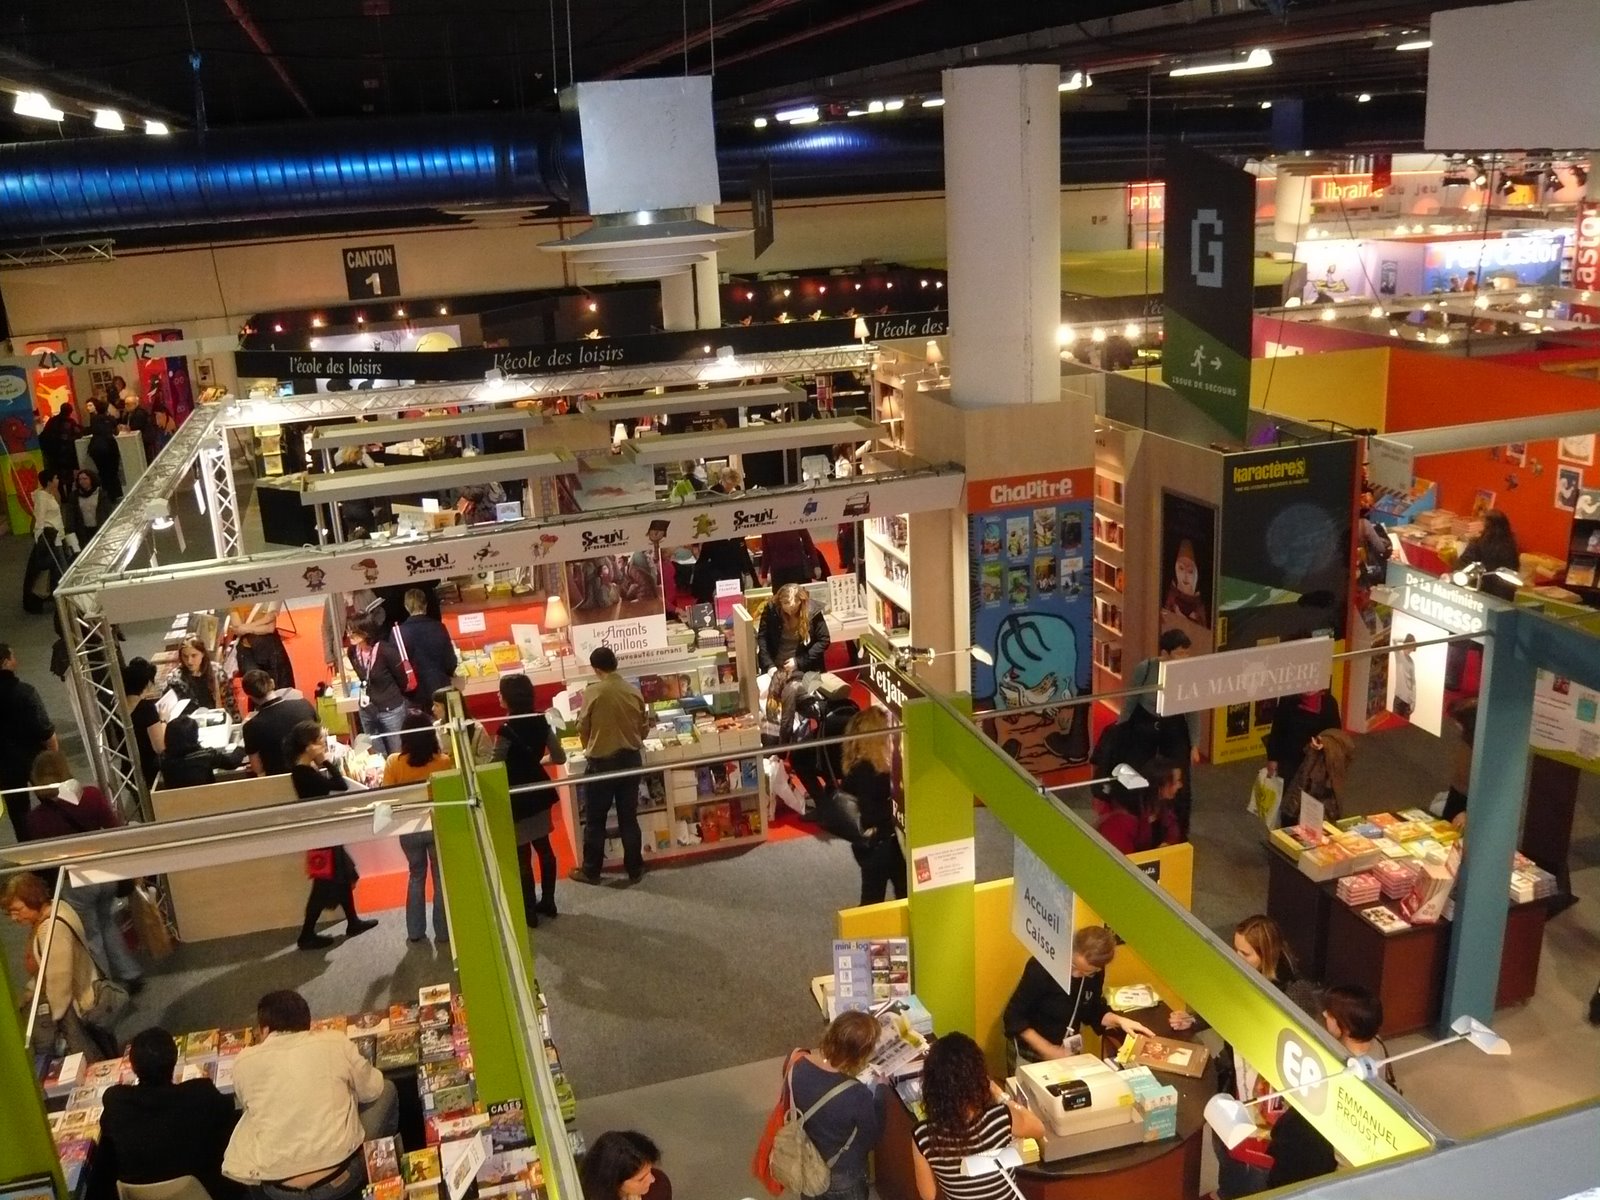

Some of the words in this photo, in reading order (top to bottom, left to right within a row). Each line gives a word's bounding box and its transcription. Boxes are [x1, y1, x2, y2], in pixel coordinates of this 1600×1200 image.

[346, 248, 393, 269] CANTON
[1190, 208, 1223, 288] G
[1576, 208, 1600, 292] asto
[365, 272, 382, 295] 1
[874, 319, 917, 339] l'école
[921, 317, 944, 334] des
[38, 351, 64, 369] LA
[68, 342, 155, 366] CHARTE
[290, 356, 322, 374] l'école
[326, 357, 344, 374] des
[348, 356, 382, 375] loisirs
[494, 349, 541, 370] l'école
[547, 348, 572, 366] des
[579, 344, 625, 364] loisirs
[1171, 375, 1193, 387] ISSUE
[1193, 381, 1203, 390] DE
[1204, 382, 1237, 397] SECOURS
[1406, 572, 1419, 588] De
[1432, 583, 1485, 613] Martinière
[603, 622, 648, 641] Amants
[617, 650, 654, 661] ouveautés
[1177, 684, 1199, 701] LA
[1208, 662, 1320, 696] MARTINIÈRE
[1024, 887, 1060, 934] Accueil
[1025, 917, 1056, 960] Caisse
[1336, 1101, 1379, 1146] PROUST
[1337, 1087, 1399, 1151] EMMANUEL
